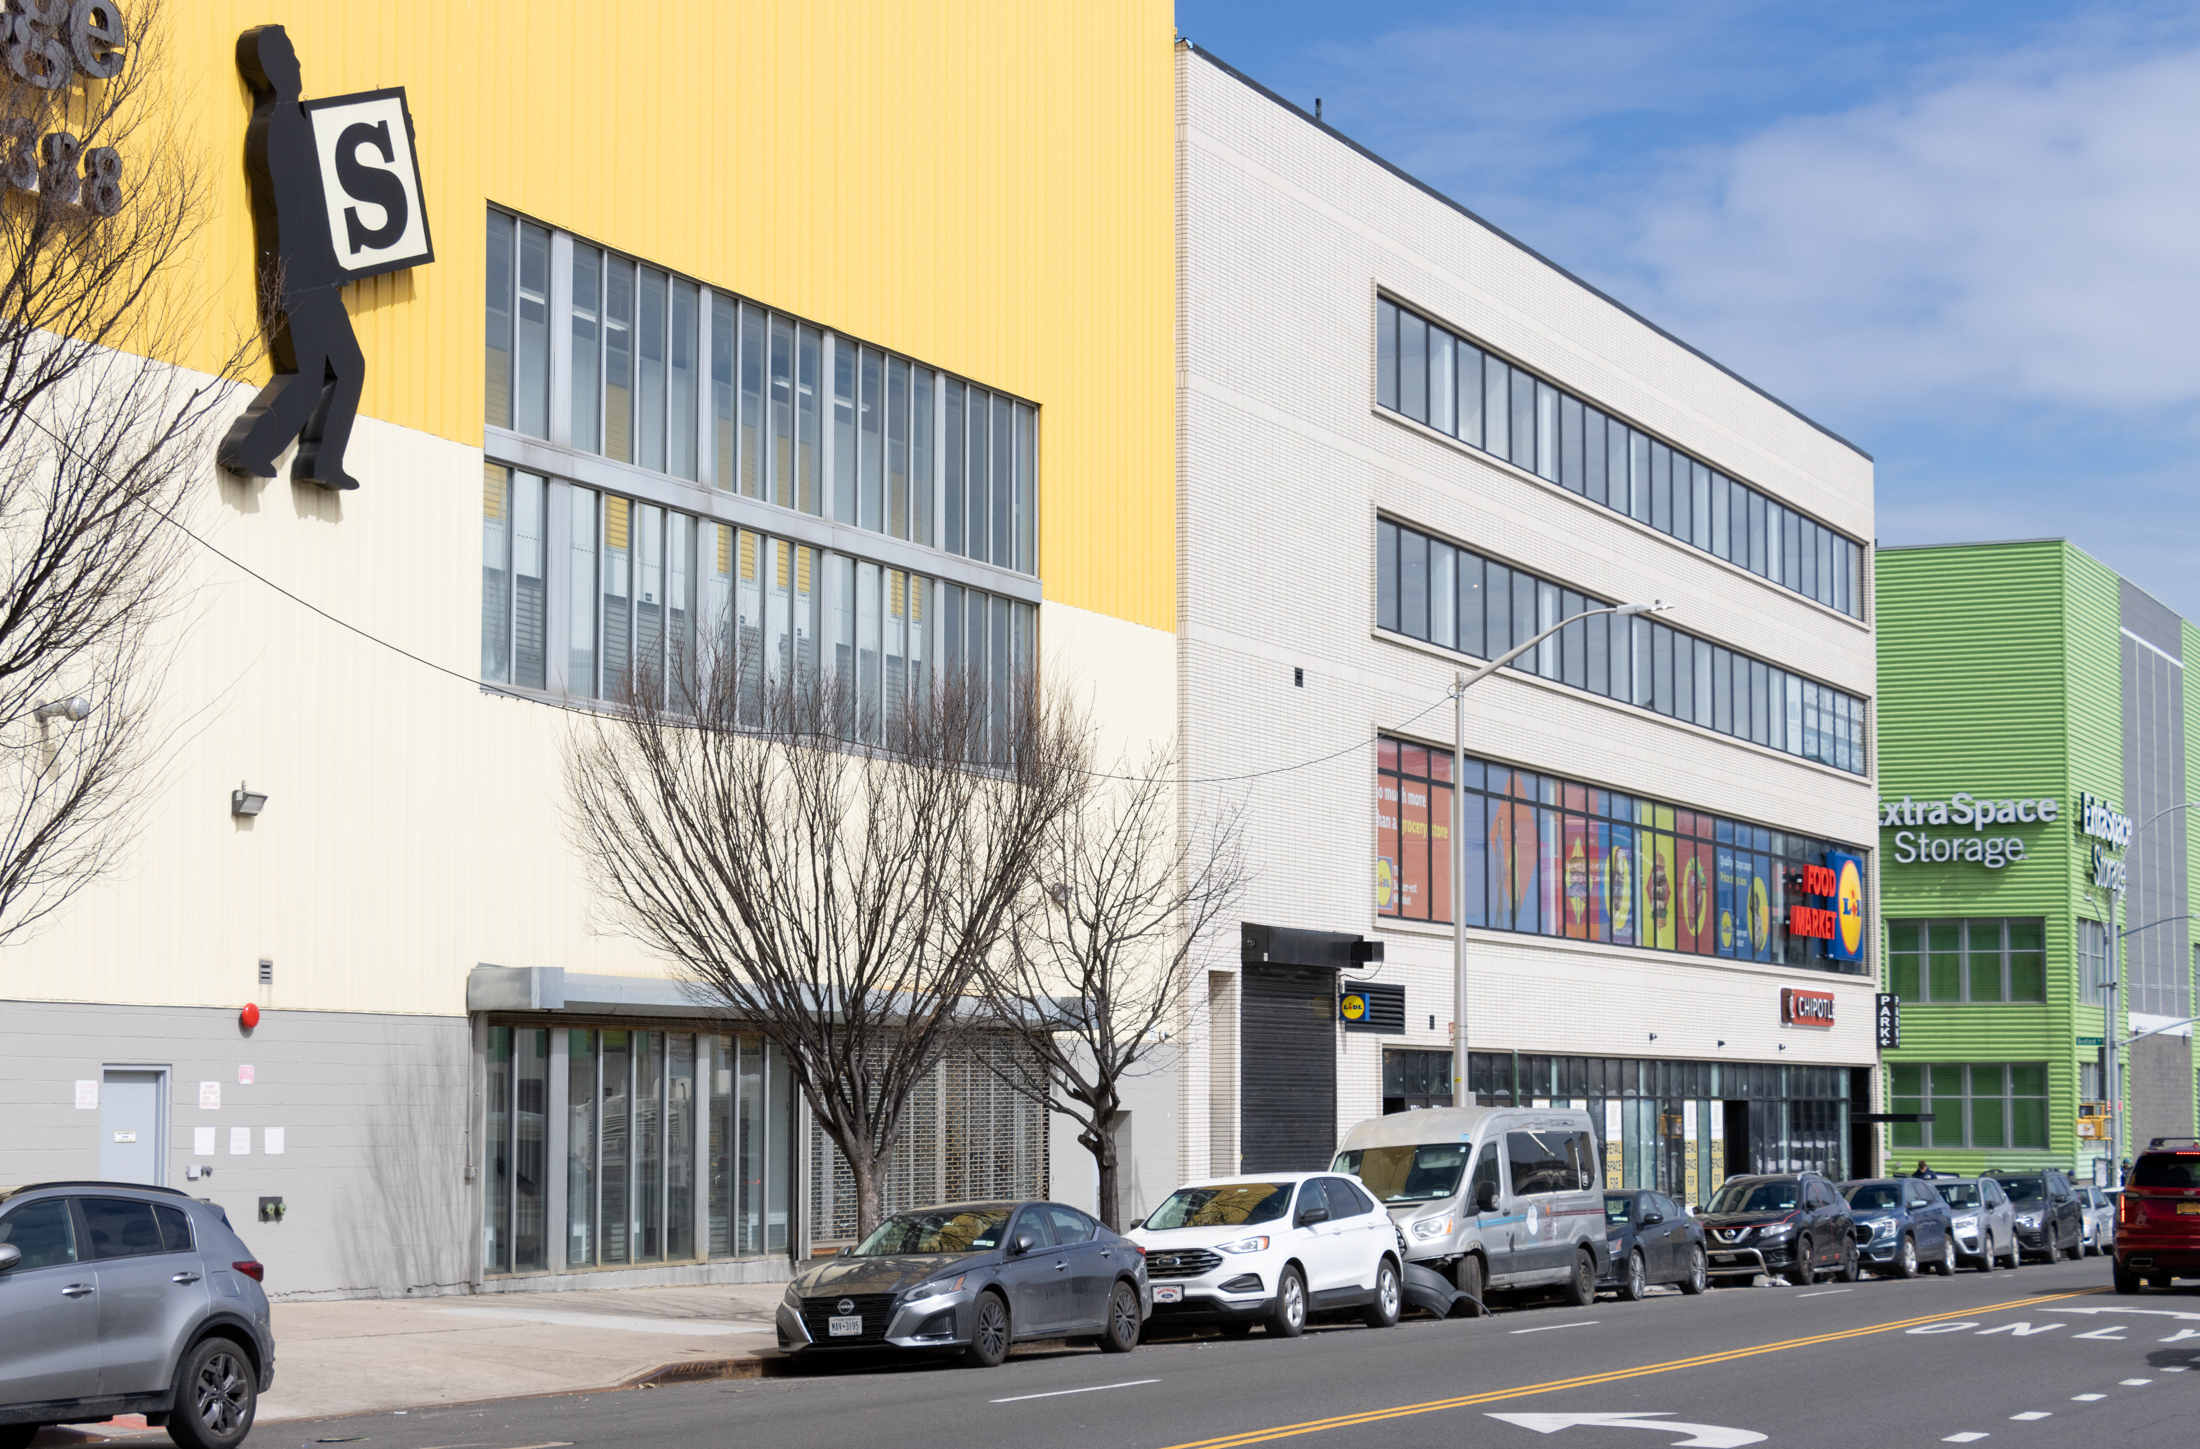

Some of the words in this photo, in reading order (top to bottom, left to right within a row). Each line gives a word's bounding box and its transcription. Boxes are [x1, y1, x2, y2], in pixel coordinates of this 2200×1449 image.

[335, 120, 409, 254] S
[1408, 792, 1427, 808] more
[1401, 819, 1428, 840] grocery
[1894, 831, 2026, 869] Storage
[1804, 864, 1837, 897] FOOD
[1791, 906, 1837, 940] MARKET
[1798, 996, 1836, 1019] CHIPOTLE
[1880, 995, 1891, 1037] PARK
[1606, 1159, 1622, 1172] SPACE
[1684, 1158, 1697, 1171] SPACE
[1711, 1157, 1723, 1169] SPACE
[1609, 1176, 1619, 1189] FOR
[1904, 1321, 2200, 1343] ONLY
